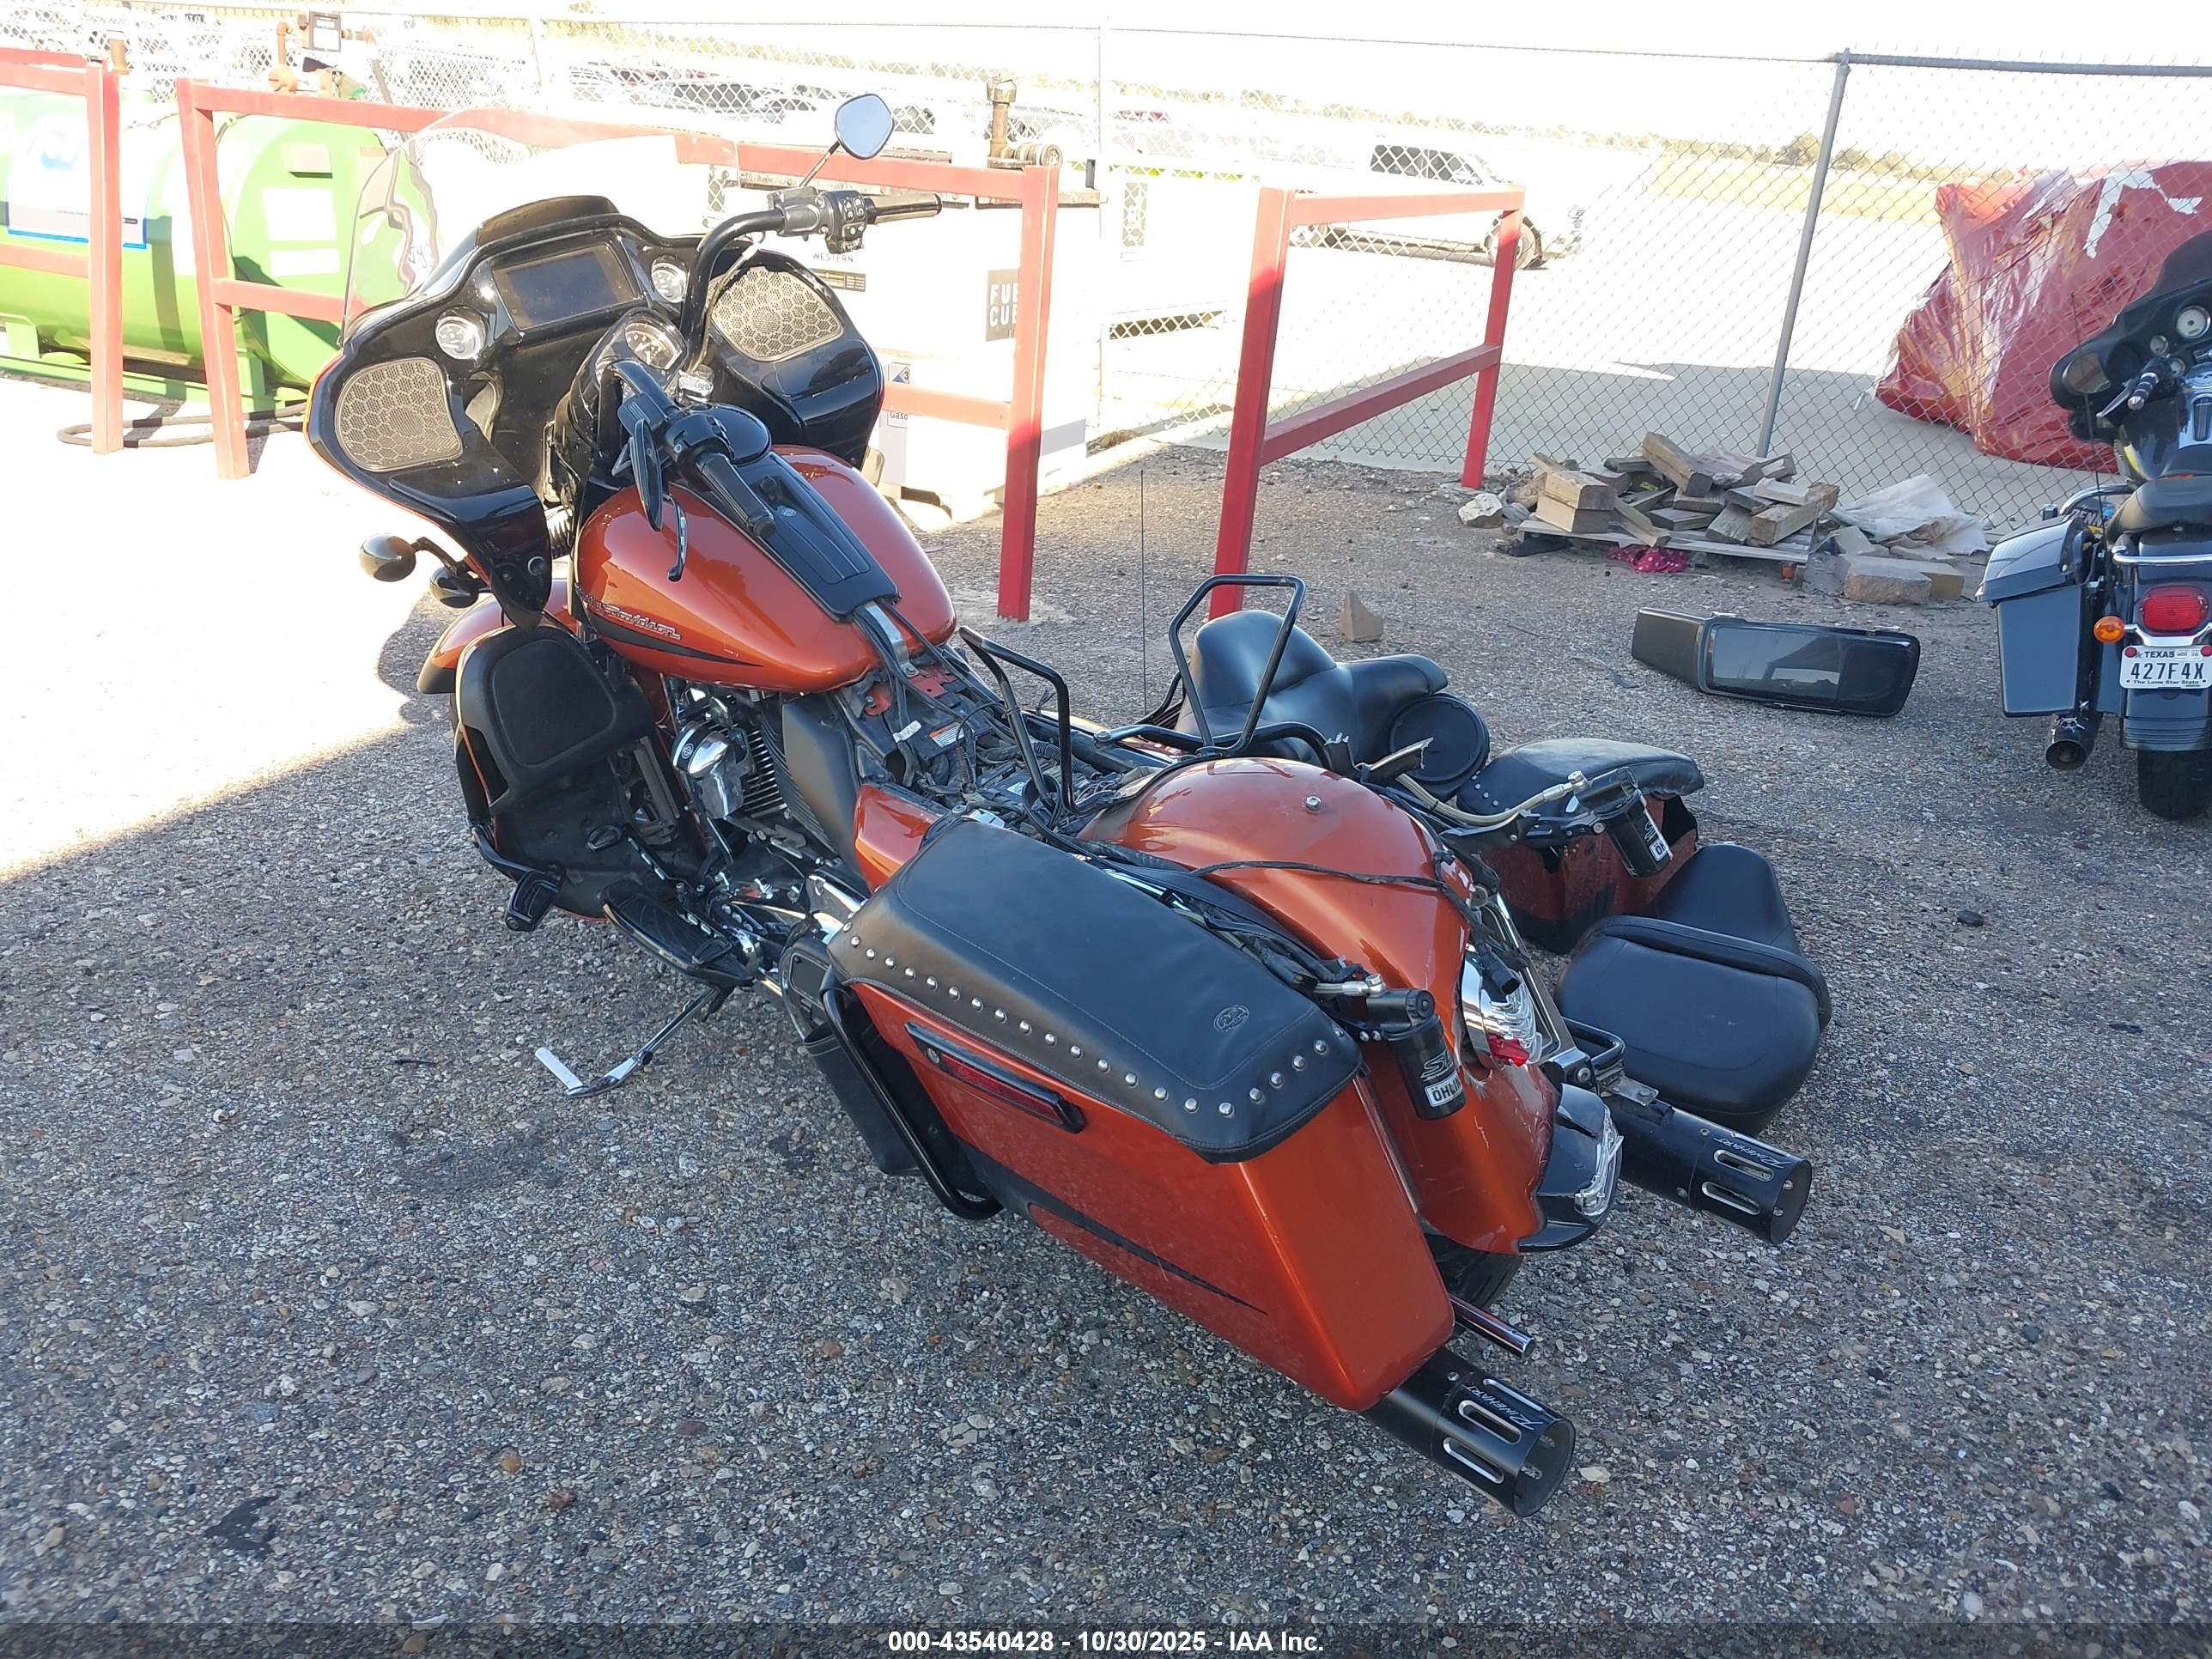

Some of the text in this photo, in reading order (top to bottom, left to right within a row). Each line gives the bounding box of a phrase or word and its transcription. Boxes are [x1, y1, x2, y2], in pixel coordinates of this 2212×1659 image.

[813, 252, 854, 264] WESTERN
[903, 371, 910, 380] 3
[2130, 662, 2204, 680] 427F4X
[1462, 1383, 1543, 1431] RINEHART
